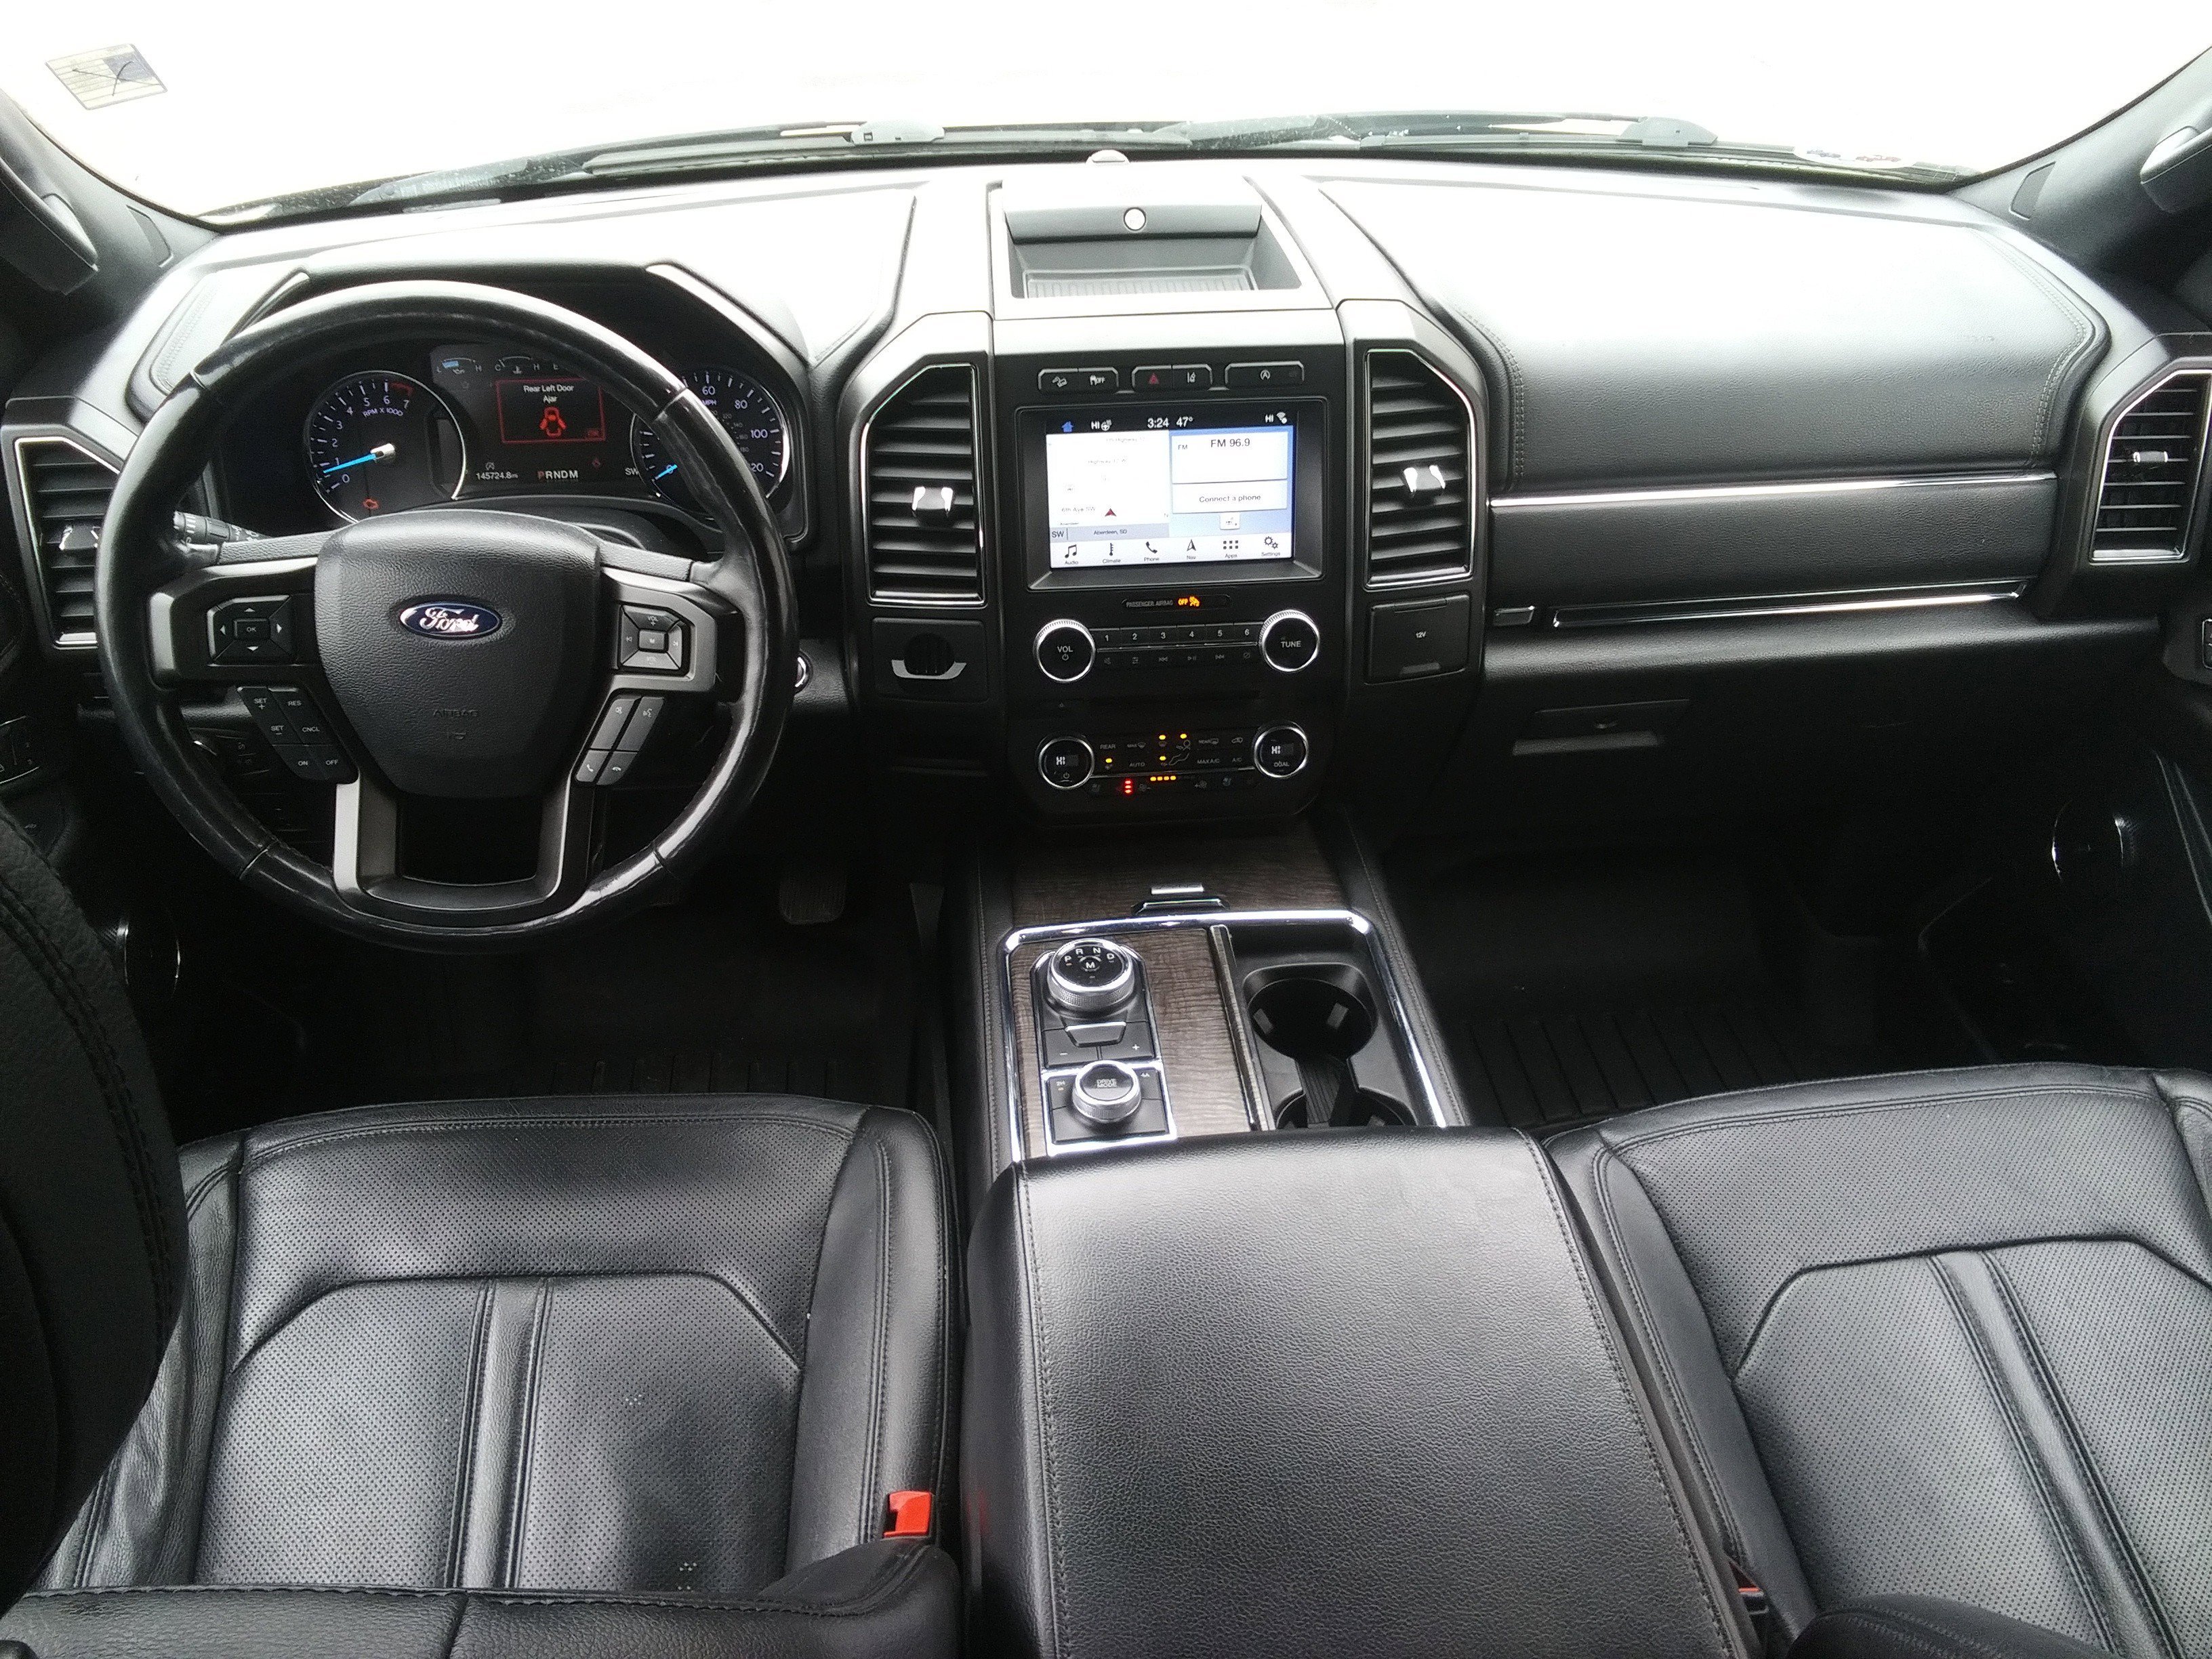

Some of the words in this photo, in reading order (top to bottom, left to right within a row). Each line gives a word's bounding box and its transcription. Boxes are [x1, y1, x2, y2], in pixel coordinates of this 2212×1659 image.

[702, 386, 716, 396] 60
[364, 397, 370, 407] 5
[384, 396, 390, 405] 6
[543, 395, 558, 404] Ajar
[734, 400, 747, 409] 80
[346, 407, 353, 415] 4
[363, 408, 378, 417] RPM
[386, 408, 403, 417] 1000
[1147, 417, 1170, 428] 3:24
[1265, 415, 1274, 423] HI
[336, 420, 343, 430] 3
[1090, 421, 1100, 429] HI
[750, 429, 768, 438] 100
[332, 438, 338, 447] 2
[1210, 439, 1226, 448] FM
[1229, 438, 1250, 447] 96.9
[751, 463, 764, 472] 20
[342, 474, 350, 483] 0
[1238, 495, 1261, 503] phone
[419, 607, 480, 633] Ford
[1416, 631, 1426, 639] 12V
[1281, 640, 1301, 649] TUNE
[1271, 745, 1281, 754] HI
[1057, 756, 1065, 765] HI
